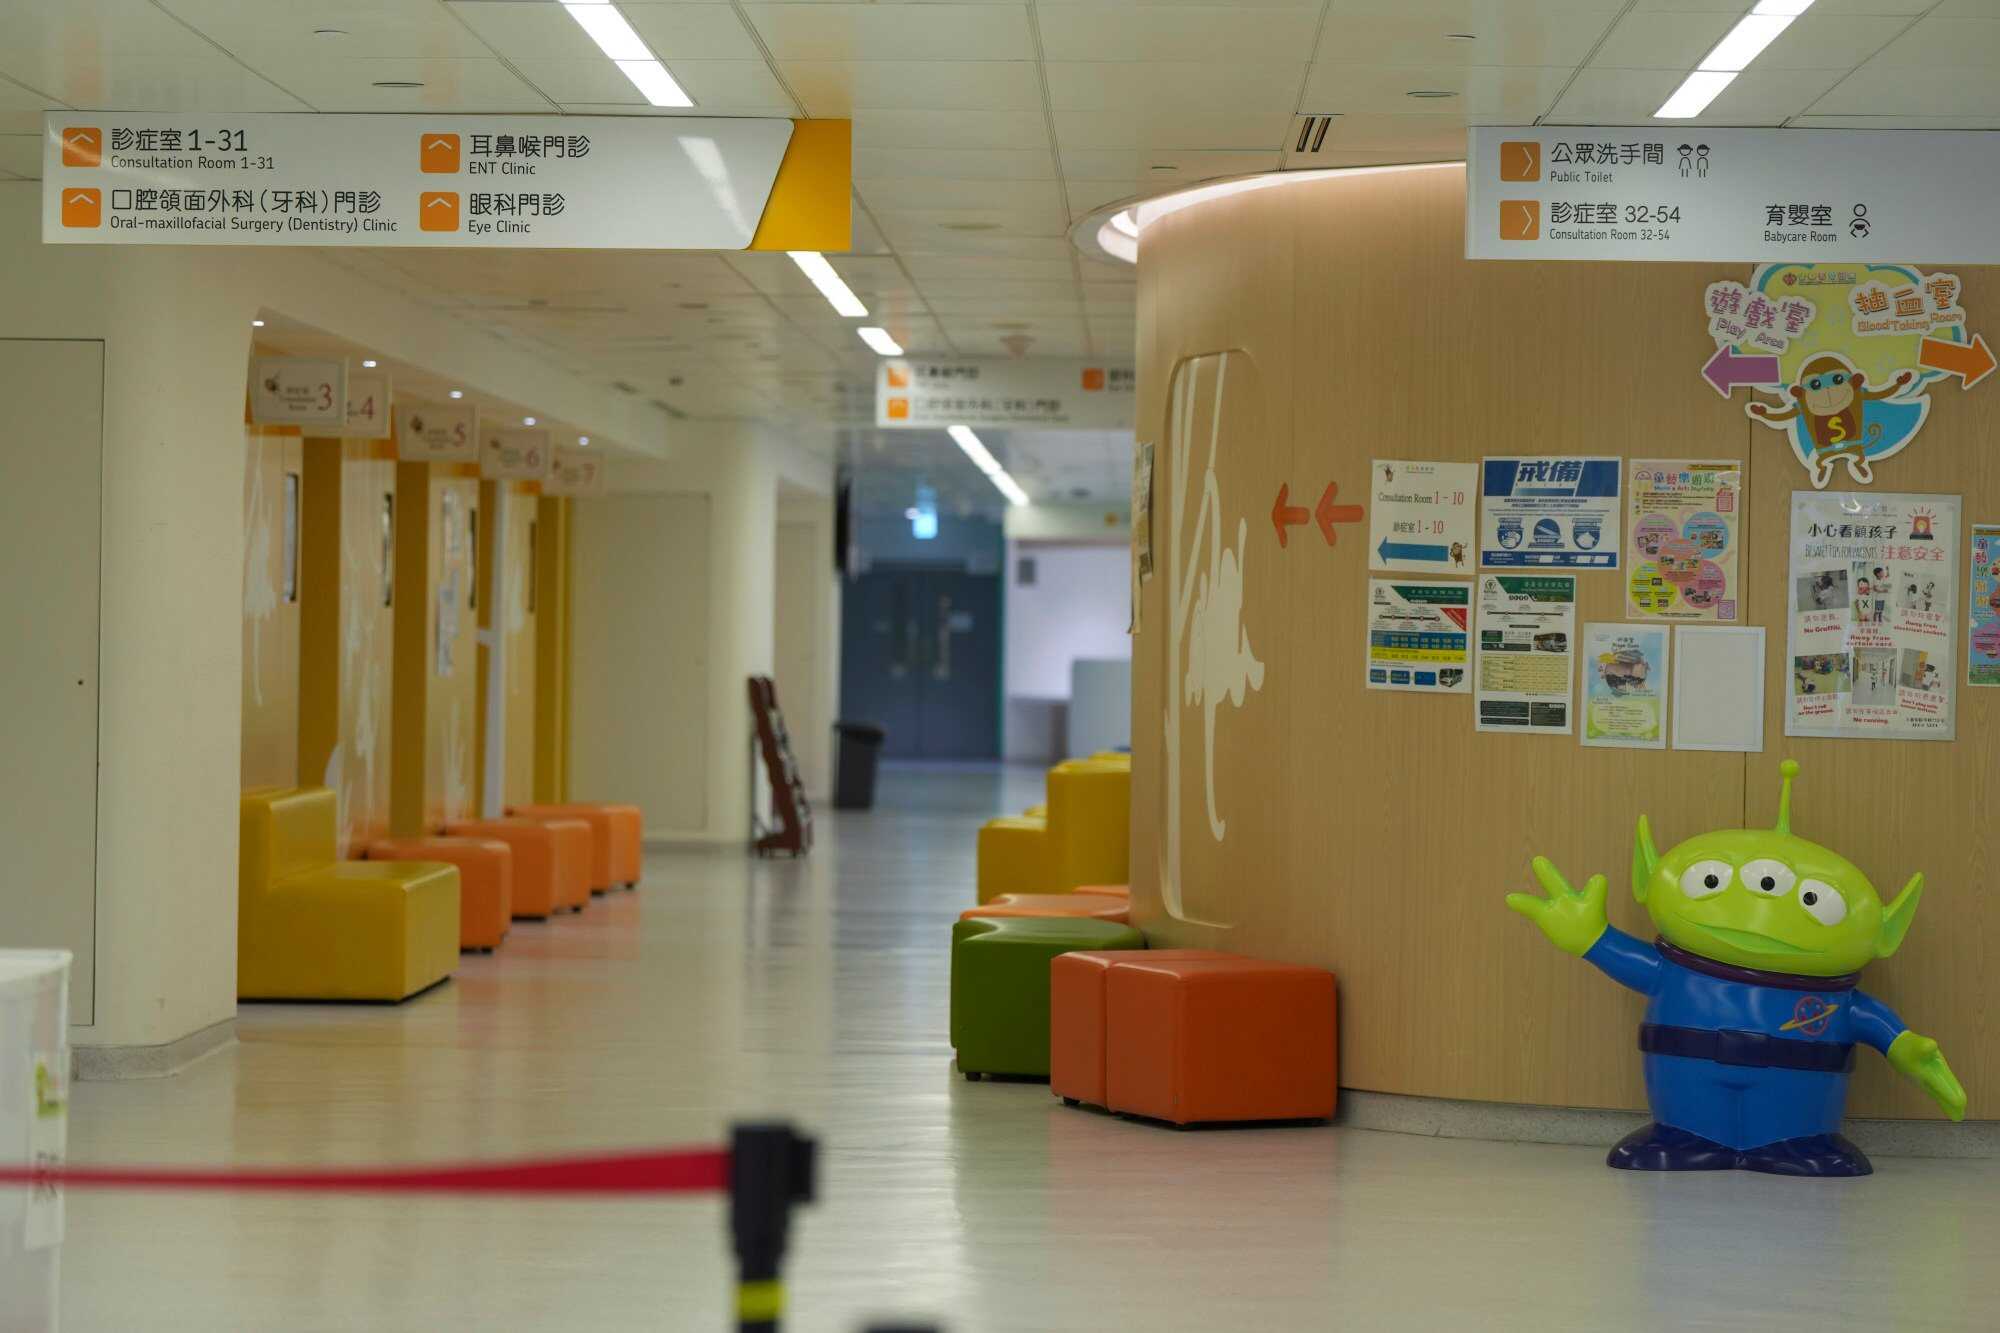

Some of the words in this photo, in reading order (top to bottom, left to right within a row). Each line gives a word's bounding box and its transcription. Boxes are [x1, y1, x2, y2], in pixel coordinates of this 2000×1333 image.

[111, 127, 183, 152] 診症室
[187, 128, 248, 152] 1-31
[469, 133, 591, 159] 耳鼻喉門診
[111, 156, 193, 169] Consultation
[198, 156, 236, 169] Room
[240, 156, 275, 169] 1-31
[1551, 142, 1664, 165] 公眾洗手間
[469, 161, 497, 175] ENT
[501, 161, 536, 175] Clinic
[1550, 170, 1581, 183] Public
[1584, 171, 1613, 183] Toilet
[469, 192, 566, 217] 眼科門診
[1550, 202, 1619, 226] 診症室
[1624, 206, 1681, 224] 32-54
[1765, 203, 1833, 227] 育嬰室
[110, 216, 226, 230] Oral-maxillofacial
[230, 217, 284, 233] Surgery
[287, 217, 358, 233] (Dentistry)
[362, 218, 398, 231] Clinic
[468, 220, 492, 235] Eye
[496, 219, 531, 233] Clinic
[1549, 228, 1608, 241] Consultation
[1610, 228, 1638, 241] Room
[1640, 229, 1670, 241] 32-54
[1764, 230, 1808, 246] Babycare
[1810, 231, 1837, 243] Room
[1716, 317, 1746, 340] Play
[1755, 332, 1785, 349] Area
[1857, 320, 1888, 332] Blood
[1889, 319, 1930, 332] Taking
[317, 382, 332, 411] 3
[360, 395, 375, 420] 4
[453, 421, 466, 448] 5
[1517, 460, 1582, 482] 戒備
[1377, 491, 1412, 504] Consultation
[1413, 493, 1433, 504] Room
[1881, 544, 1945, 562] 注意安全
